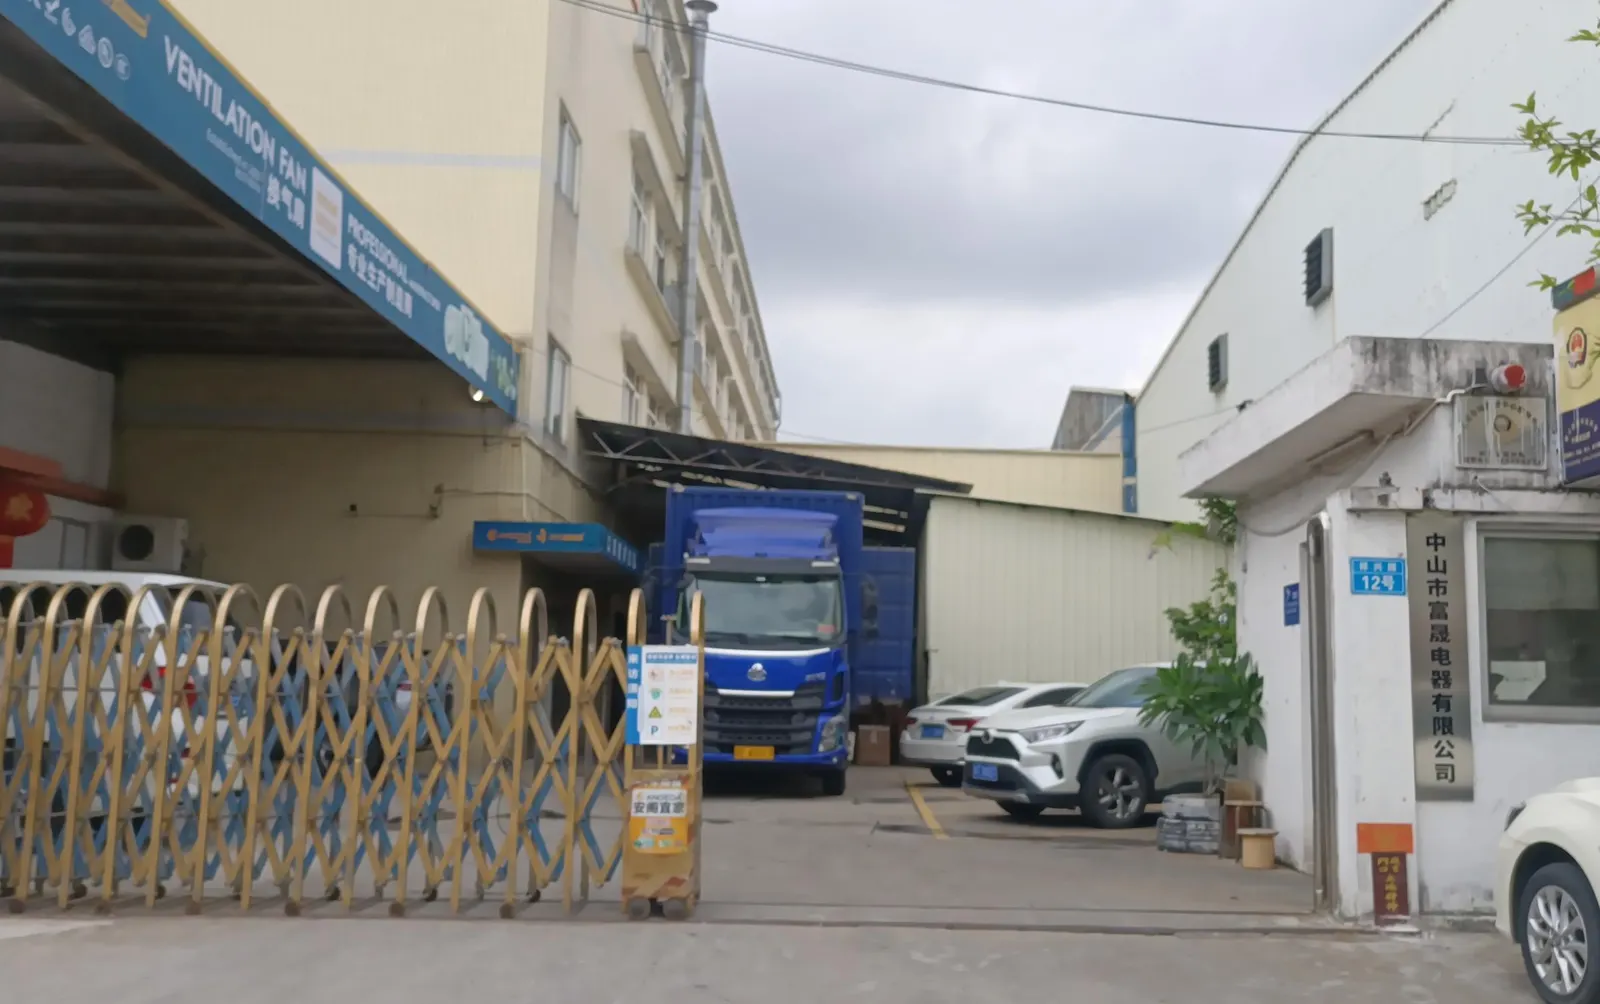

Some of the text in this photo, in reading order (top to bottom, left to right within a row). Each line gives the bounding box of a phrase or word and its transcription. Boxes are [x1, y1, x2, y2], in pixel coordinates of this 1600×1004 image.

[164, 35, 275, 167] VENTILATION
[279, 146, 307, 195] FAN
[1425, 532, 1456, 784] 中山市富晟电器有限公司
